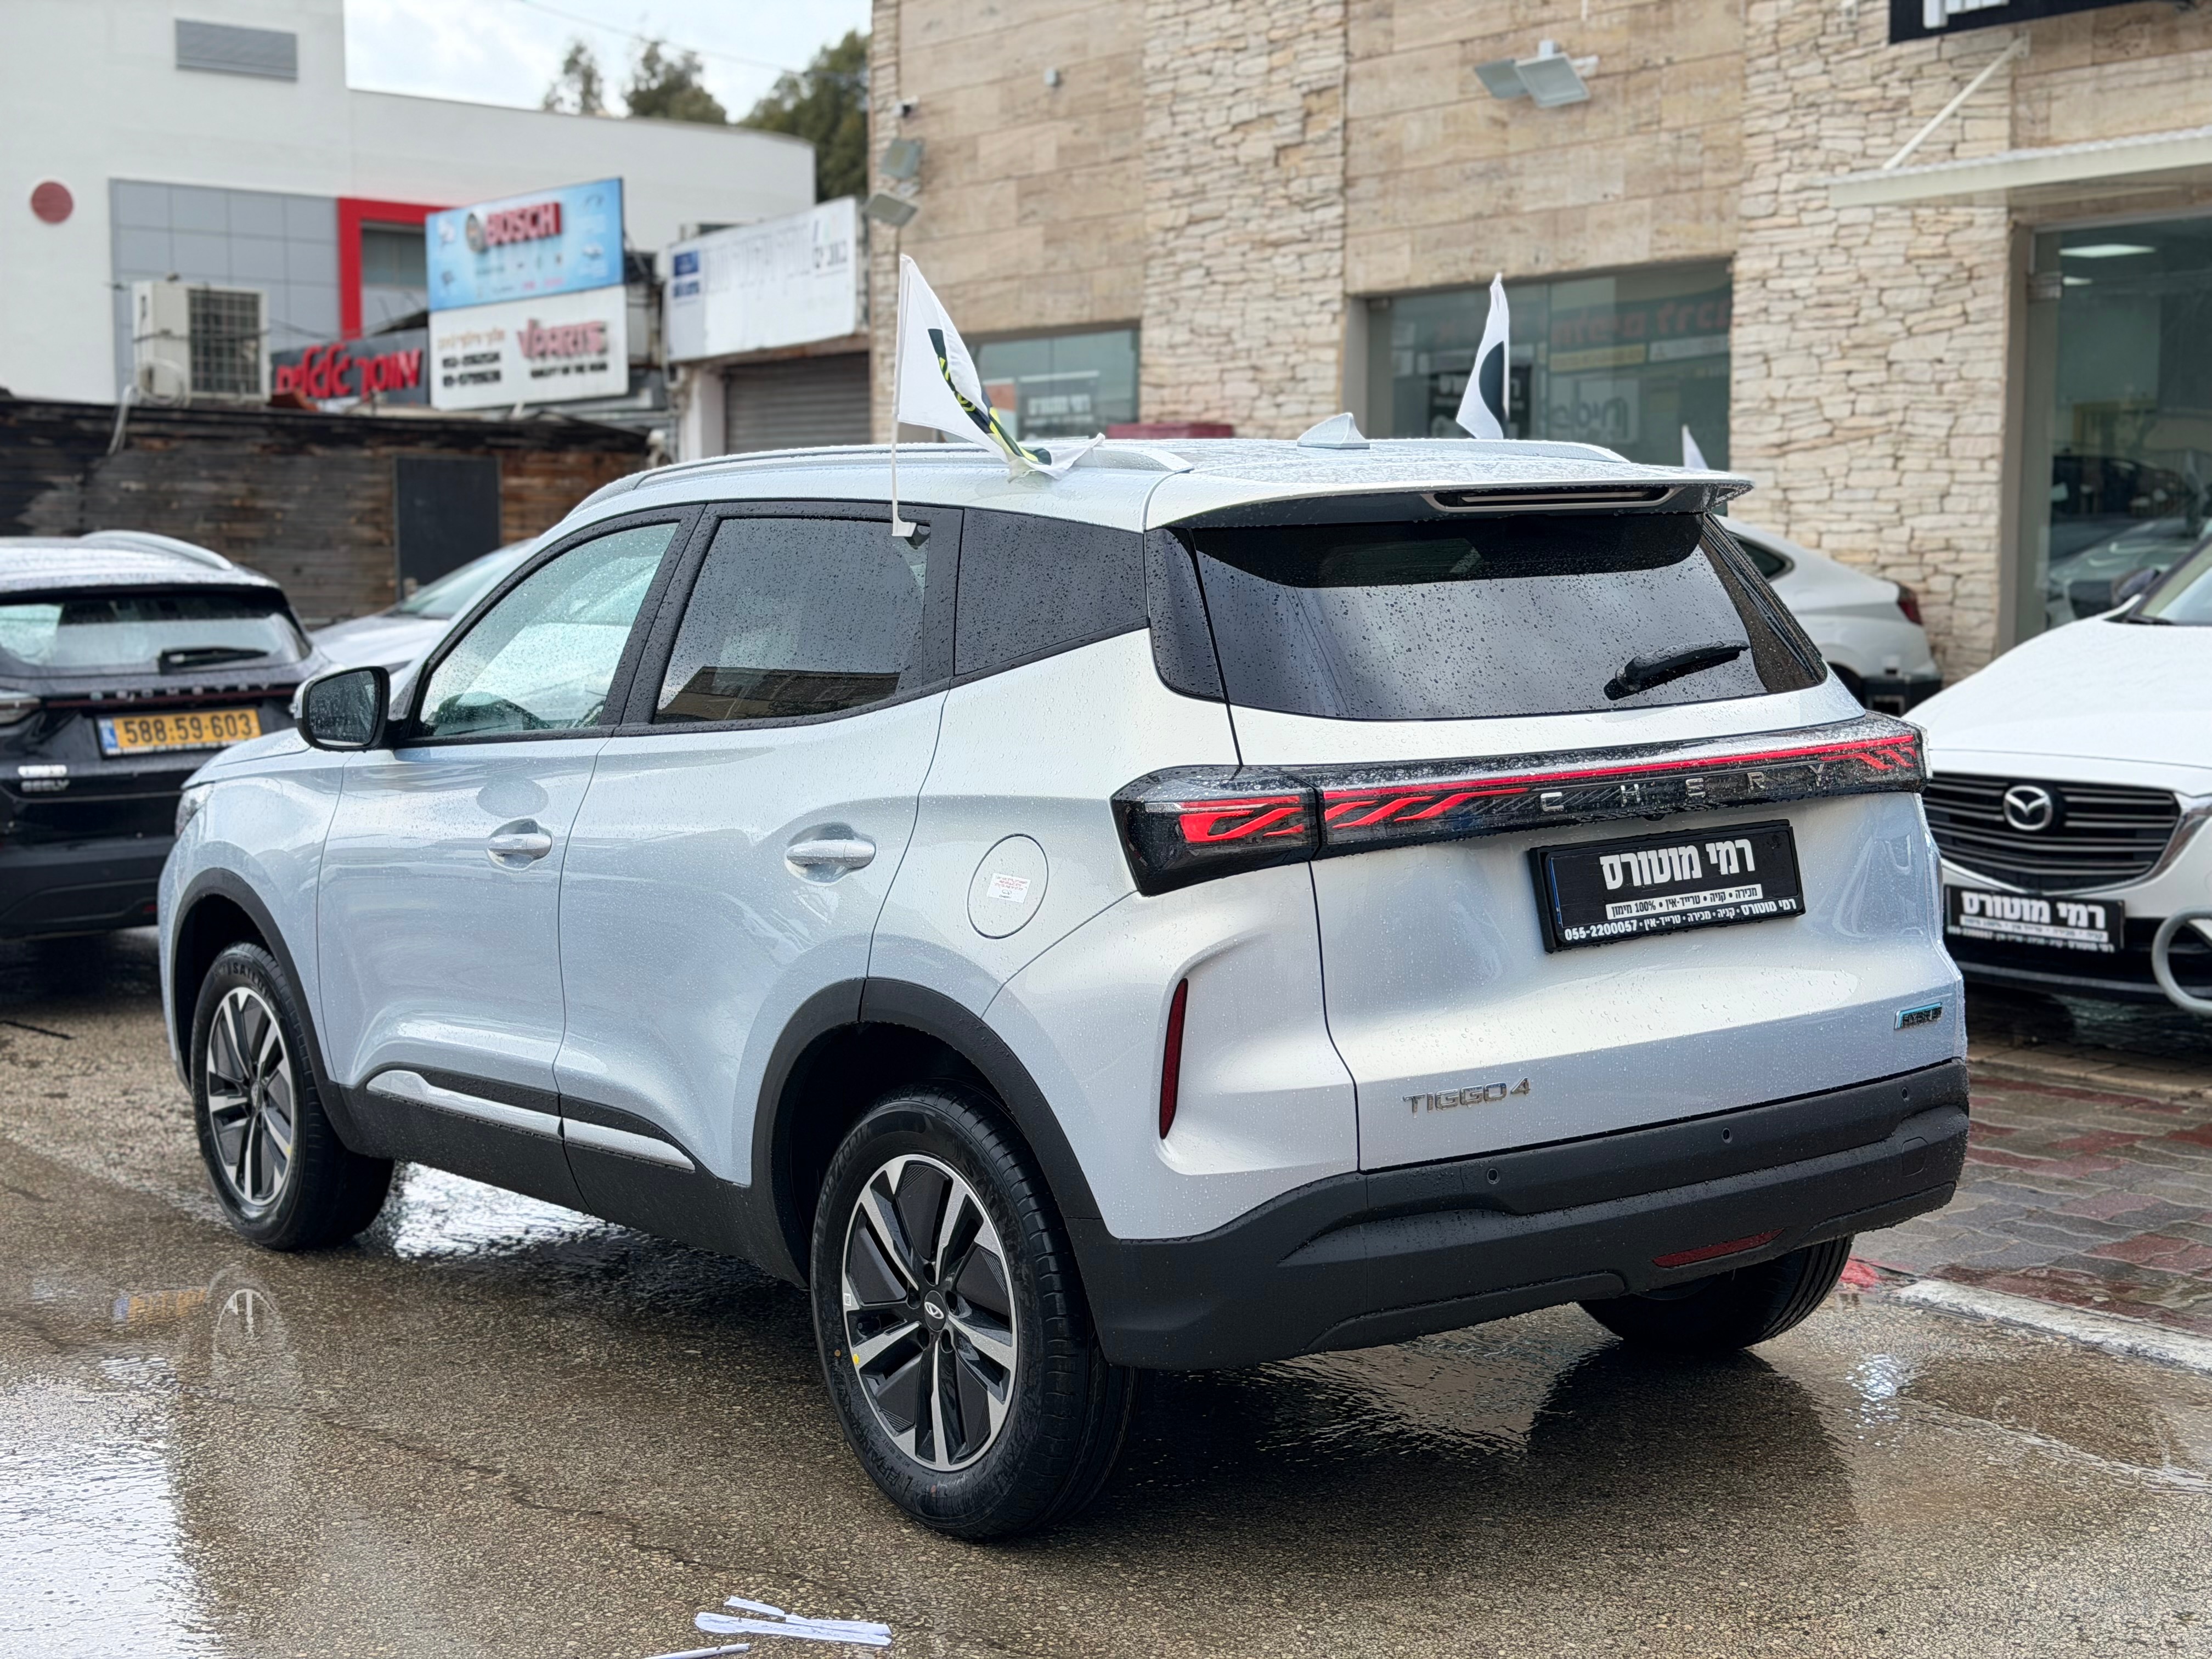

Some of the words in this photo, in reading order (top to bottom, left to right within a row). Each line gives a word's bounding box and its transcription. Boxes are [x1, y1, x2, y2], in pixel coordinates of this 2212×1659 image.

[486, 202, 561, 246] BOSCH
[1541, 764, 1824, 812] CHERY
[1705, 838, 1756, 875] רמי
[1599, 845, 1702, 890] מוטורס
[1709, 891, 1726, 903] קניה
[1735, 887, 1758, 900] מכירה
[1611, 905, 1633, 918] מימון
[1635, 900, 1656, 913] 100%
[1664, 895, 1701, 911] טרייד-אין
[1740, 900, 1778, 916] מוטורס
[1778, 898, 1797, 911] רמי
[1961, 891, 2051, 924] מוטורס
[1686, 910, 1712, 923] מכירה
[1716, 907, 1736, 919] קניה
[2056, 901, 2106, 929] רמי
[1565, 919, 1638, 941] 055-2200057
[1644, 913, 1681, 931] טרייד-אין
[1402, 1081, 1508, 1115] TIGGO
[1510, 1076, 1531, 1096] 4
